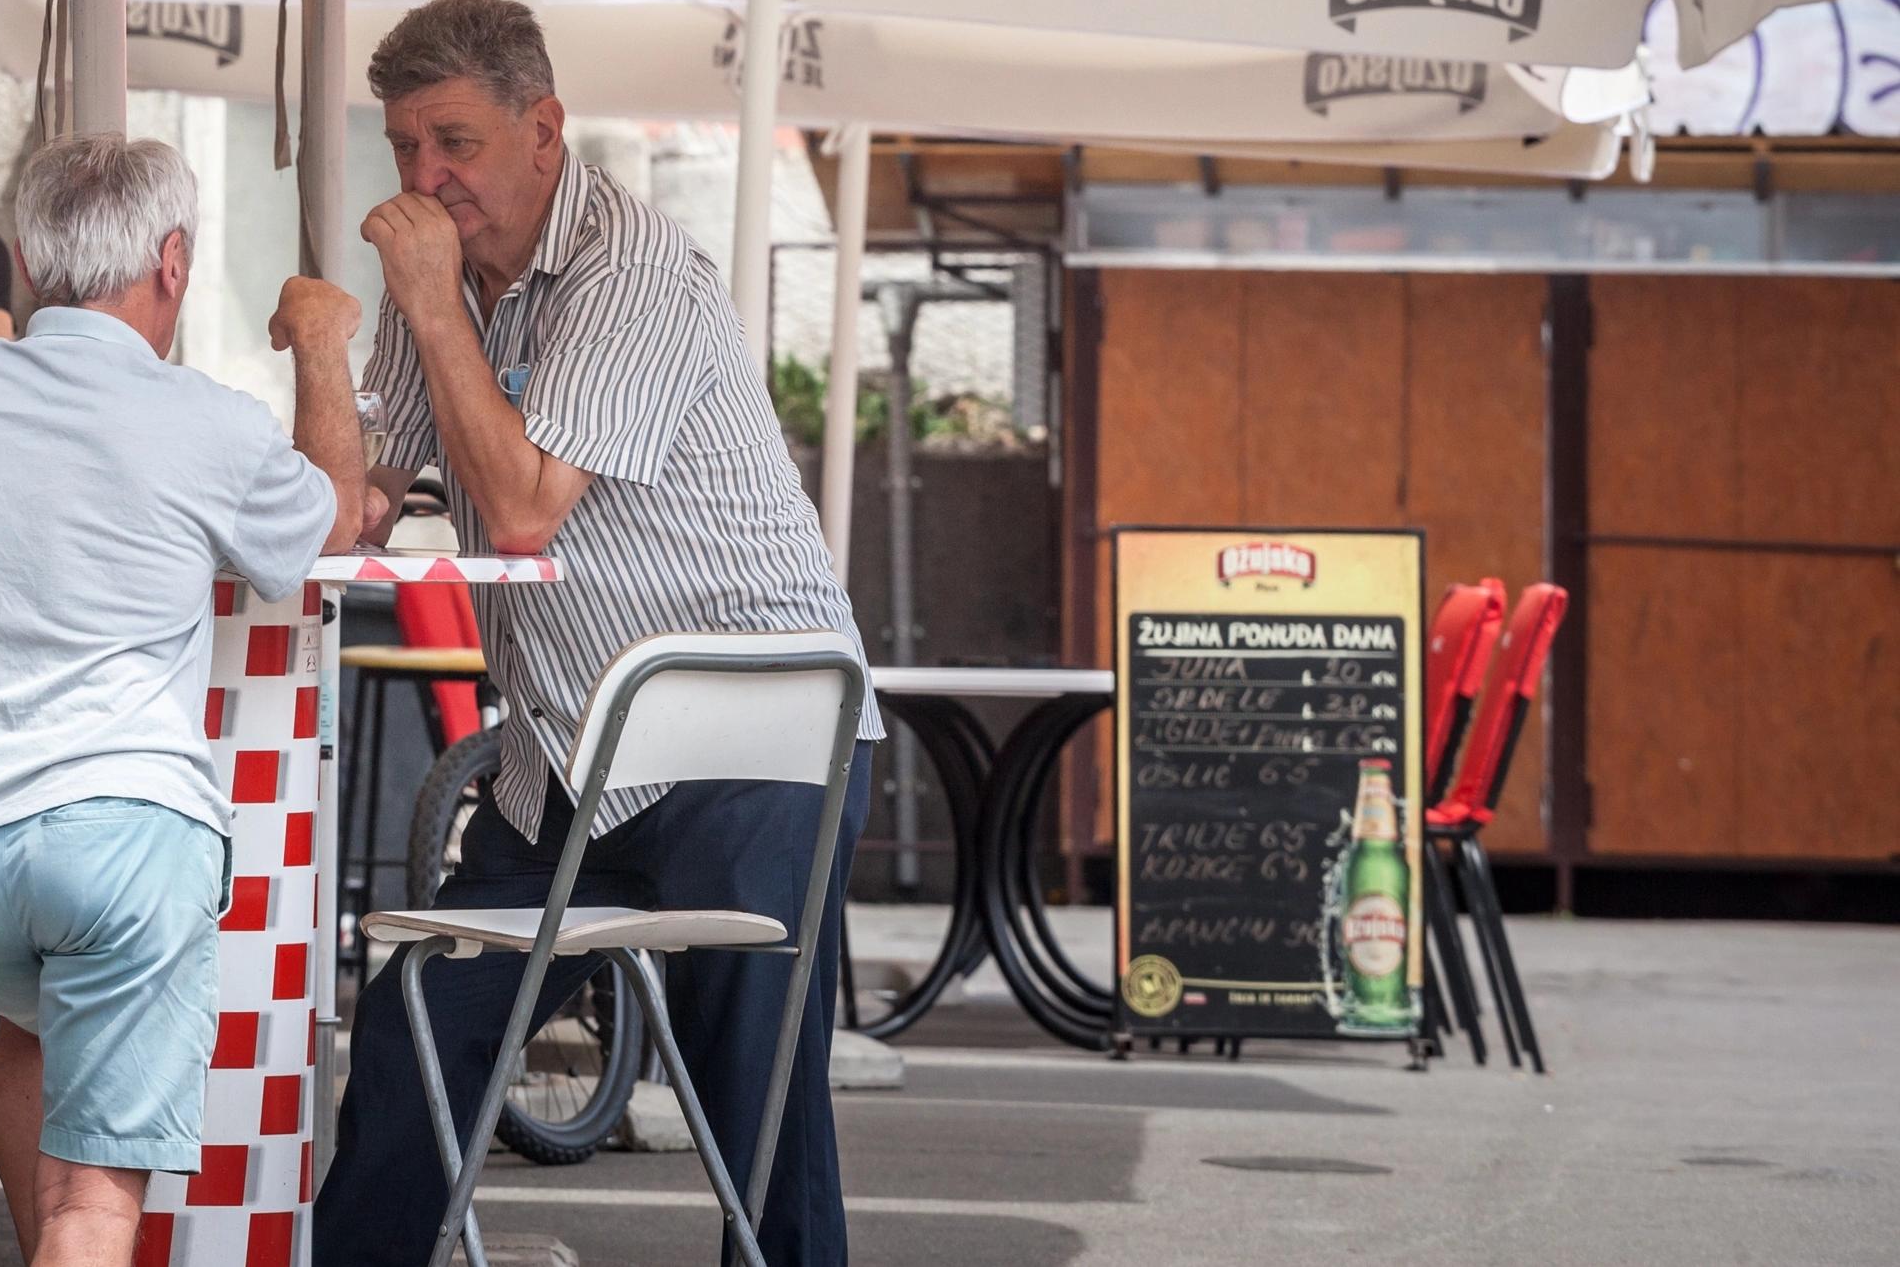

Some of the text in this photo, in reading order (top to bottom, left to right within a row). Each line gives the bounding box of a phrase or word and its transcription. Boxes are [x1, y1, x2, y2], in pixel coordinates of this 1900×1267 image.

[1137, 616, 1397, 649] ŽUJINA PONUDA DANA
